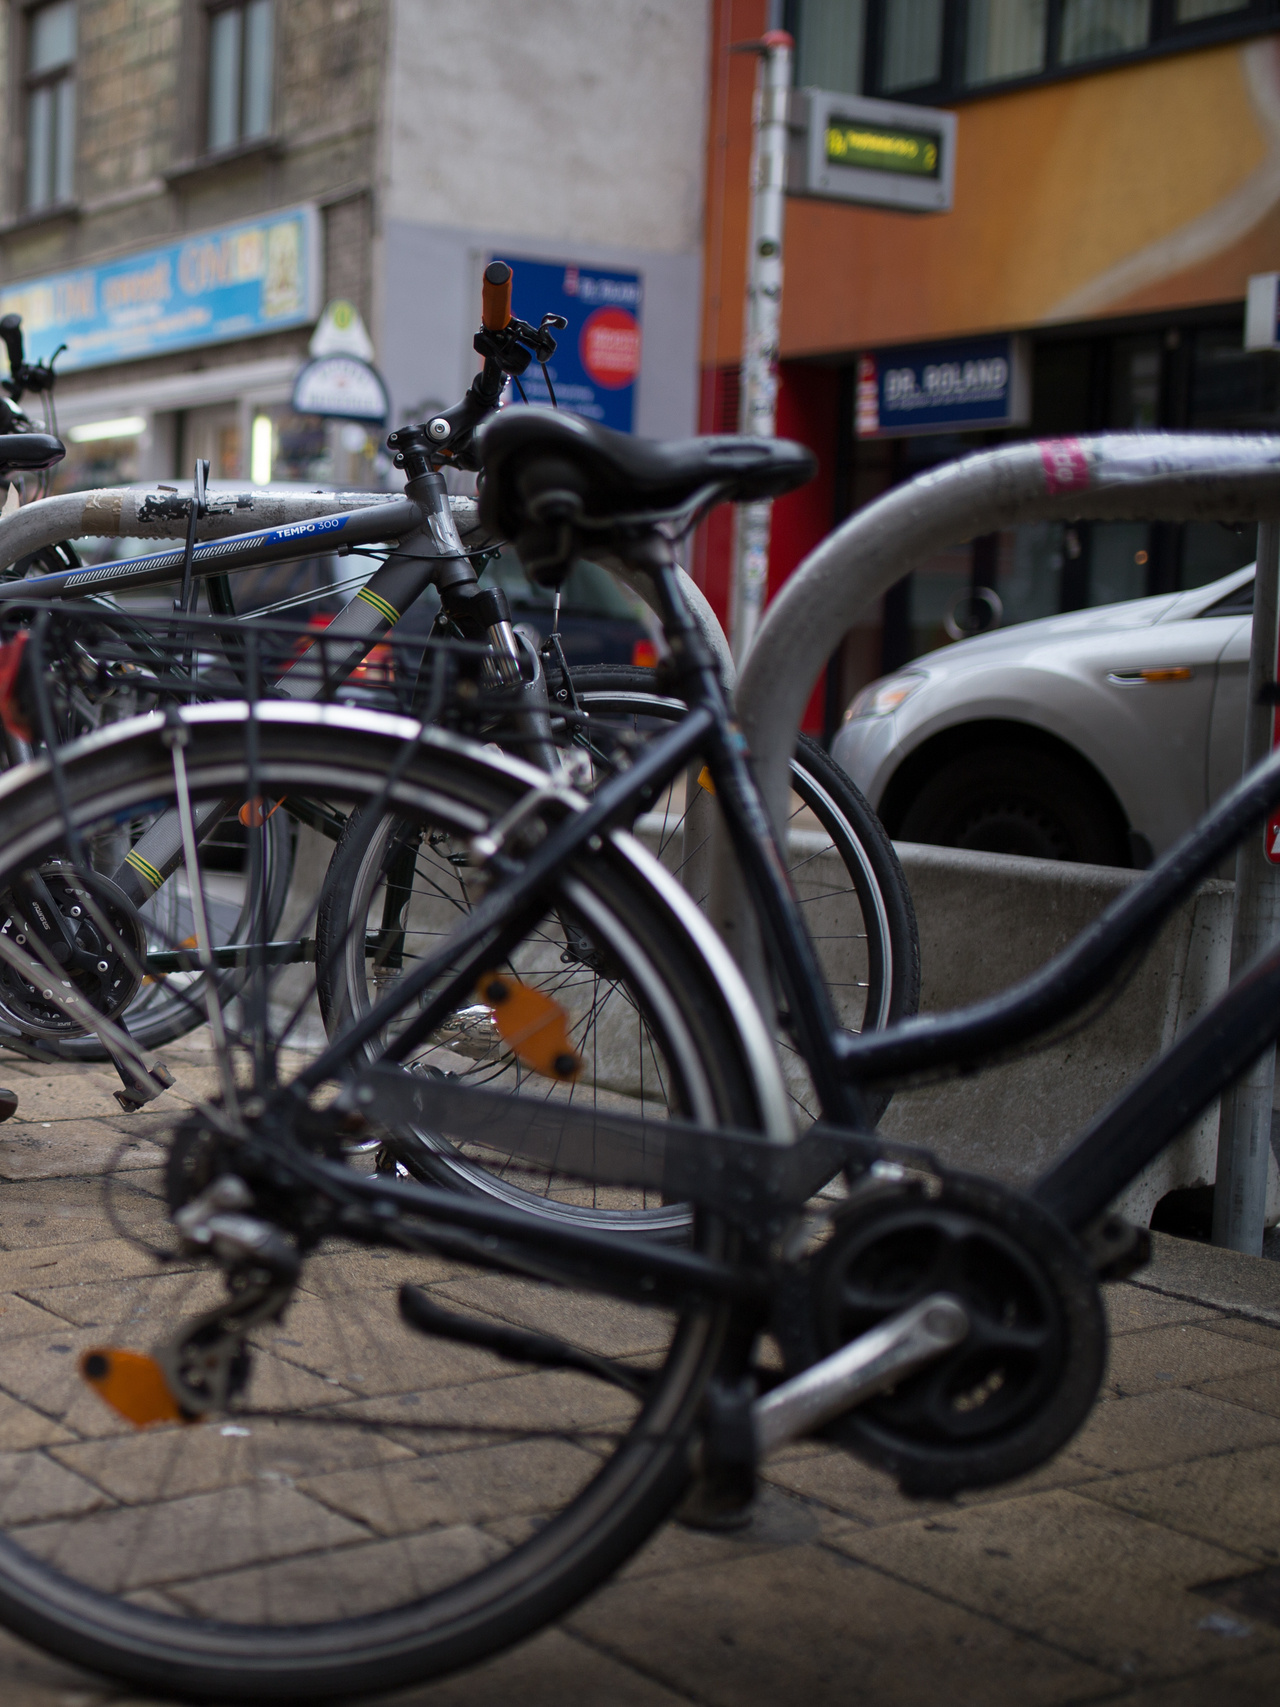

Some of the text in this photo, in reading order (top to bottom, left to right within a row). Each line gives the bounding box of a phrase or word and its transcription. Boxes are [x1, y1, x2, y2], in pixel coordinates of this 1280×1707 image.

[923, 357, 1007, 395] ROLAND
[276, 519, 339, 538] TEMPO 300
